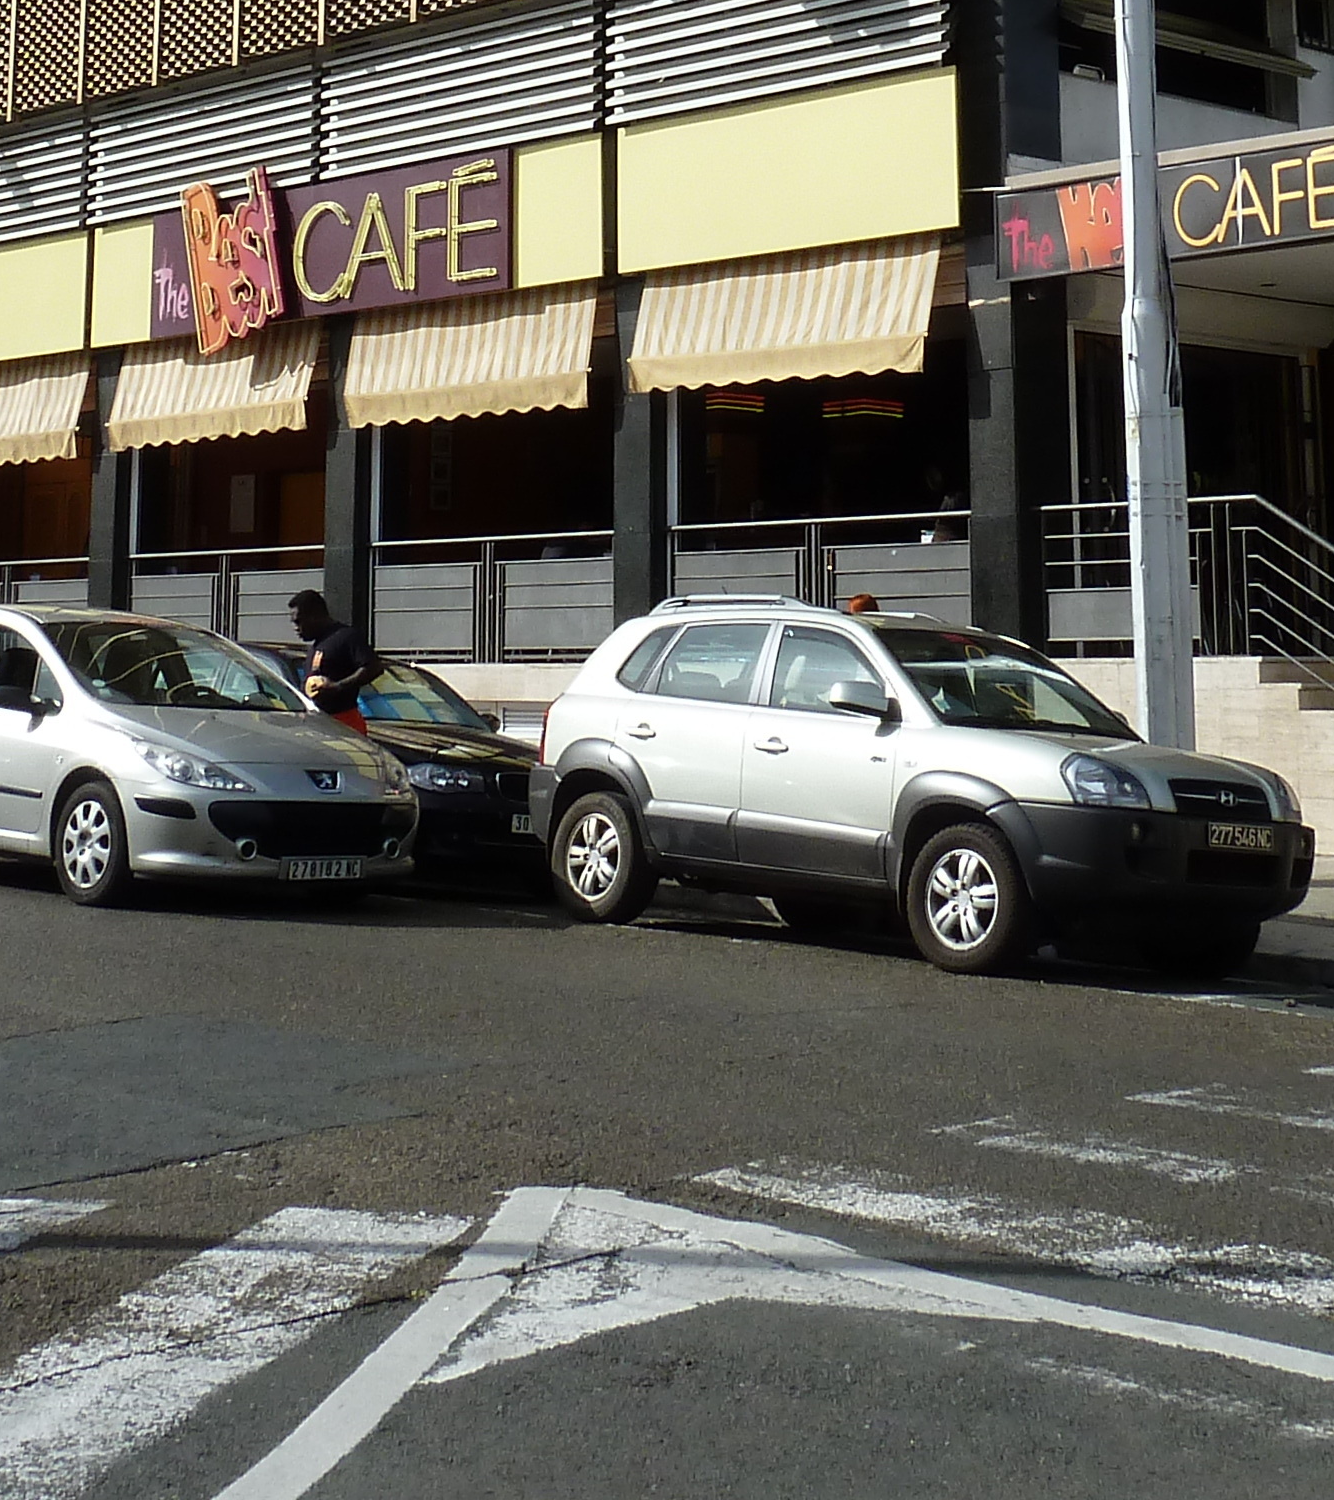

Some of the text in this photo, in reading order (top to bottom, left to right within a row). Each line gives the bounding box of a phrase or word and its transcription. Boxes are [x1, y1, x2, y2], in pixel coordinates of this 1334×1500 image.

[154, 158, 498, 357] The Best CAFÉ
[1001, 204, 1055, 273] The
[1211, 825, 1234, 844] 277
[1257, 828, 1272, 848] NC
